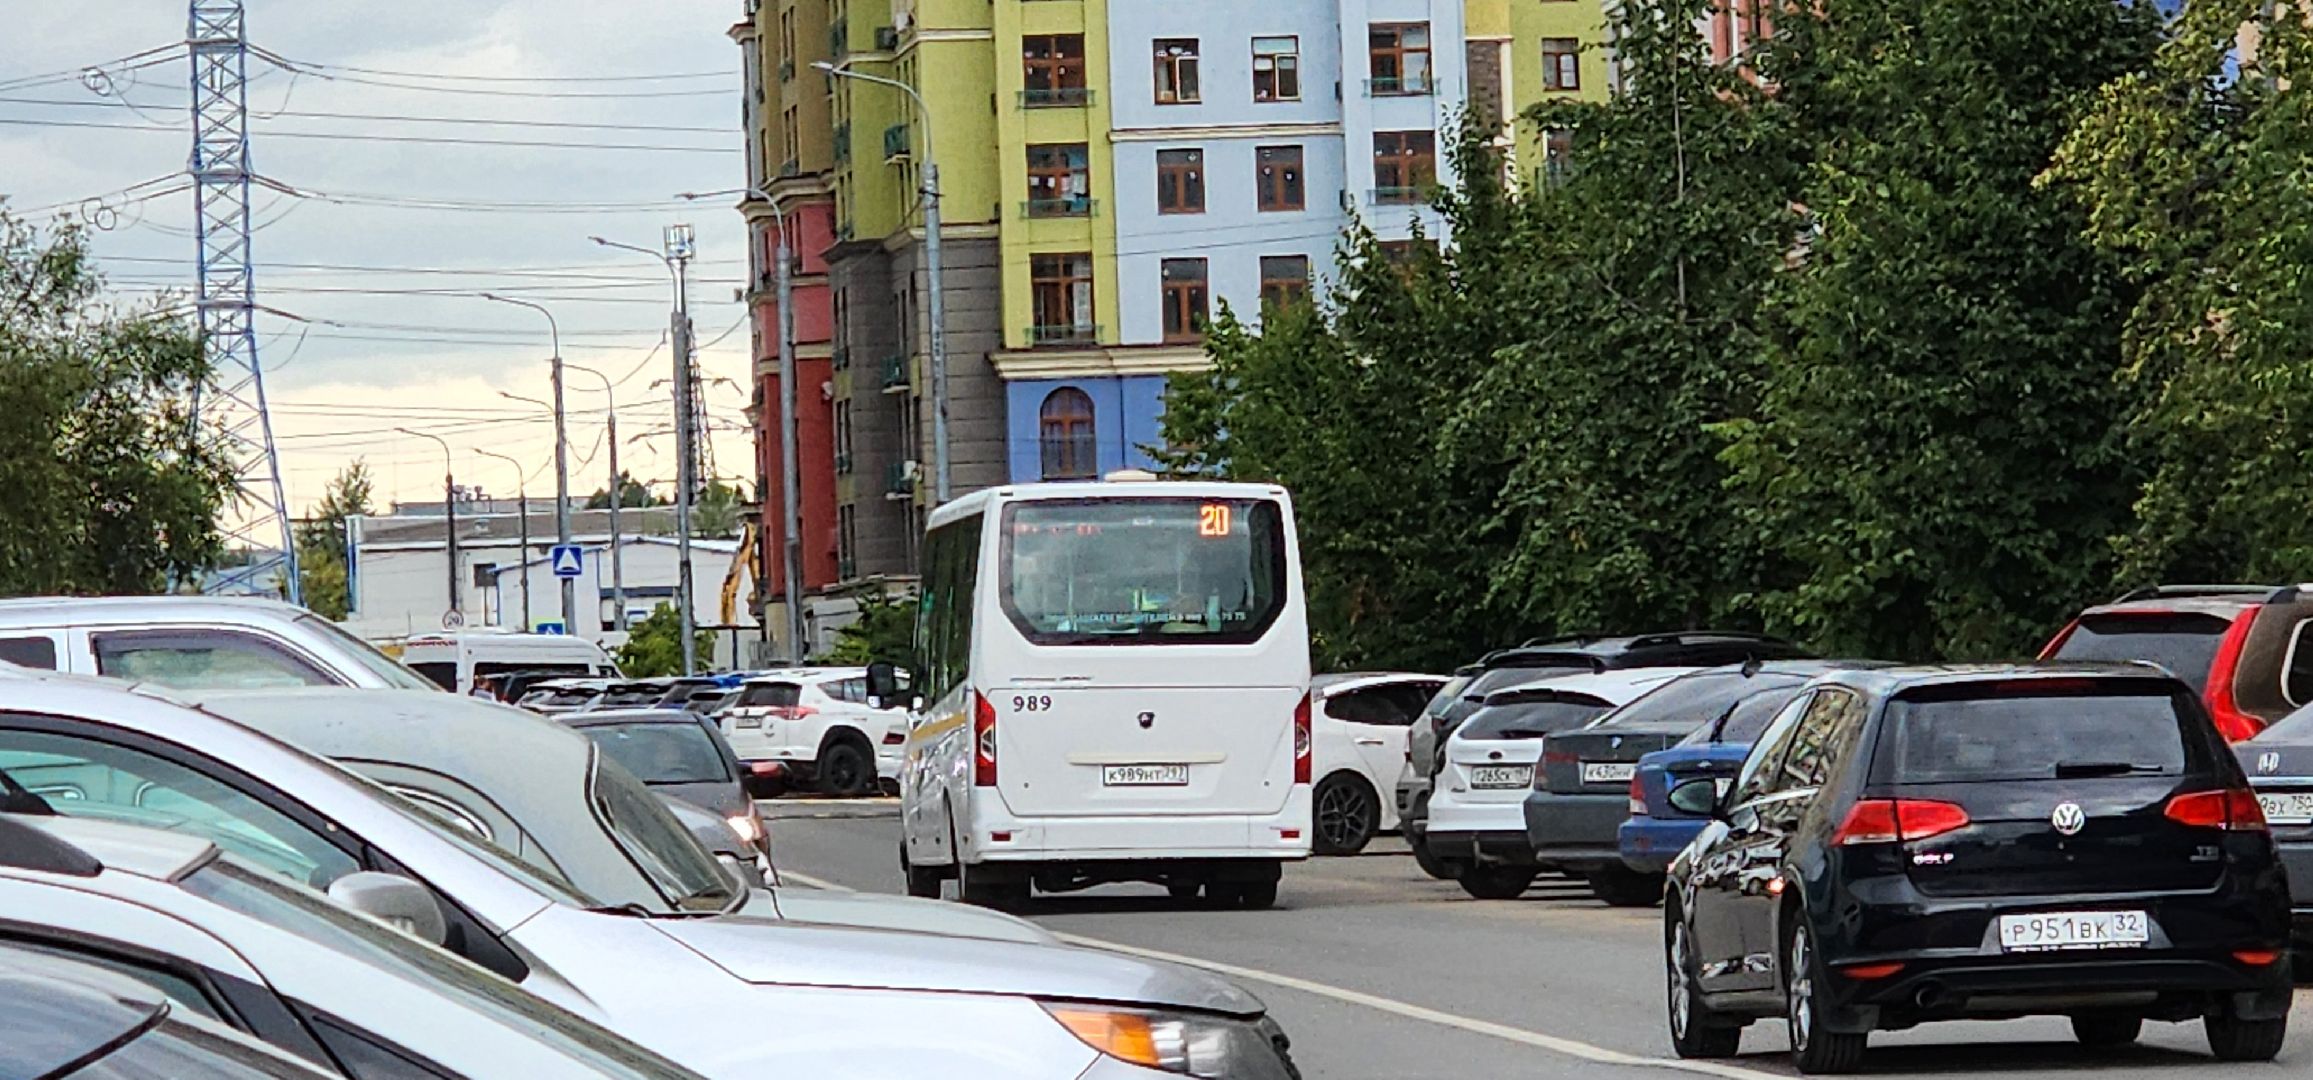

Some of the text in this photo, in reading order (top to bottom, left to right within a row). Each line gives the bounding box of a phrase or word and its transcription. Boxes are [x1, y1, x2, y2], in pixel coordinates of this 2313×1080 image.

[1200, 504, 1229, 536] 20
[1013, 695, 1052, 712] 989
[2013, 914, 2138, 942] Р951ВК 32
